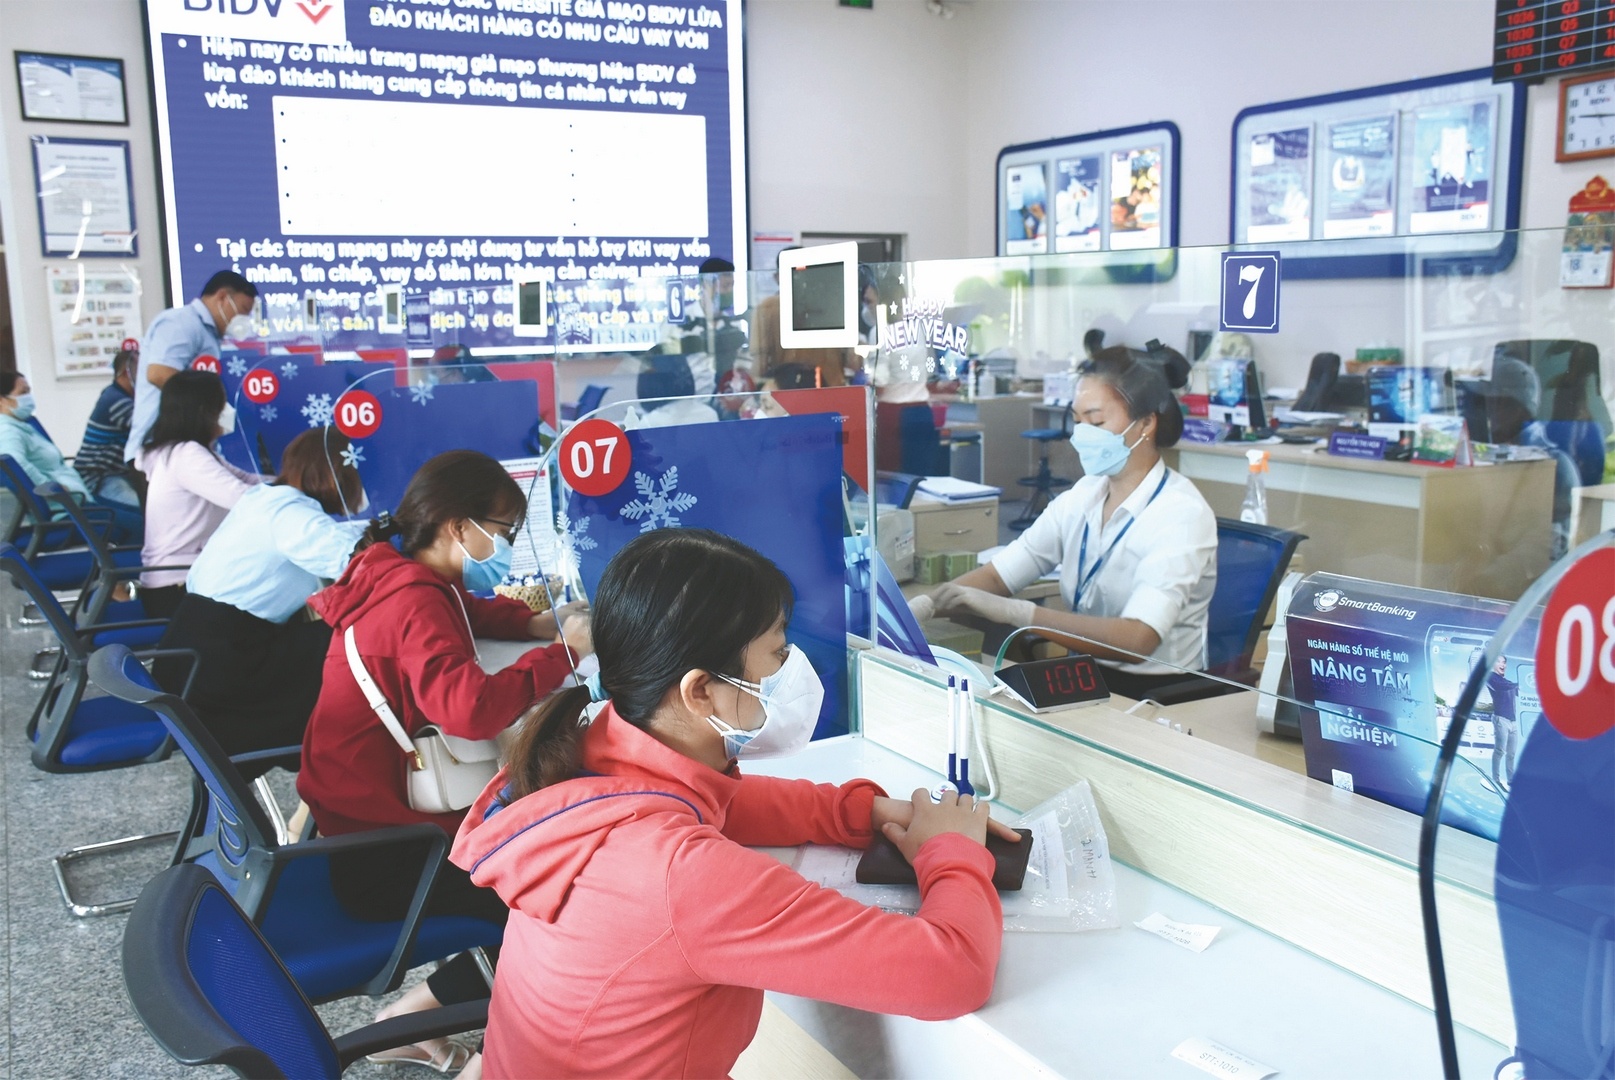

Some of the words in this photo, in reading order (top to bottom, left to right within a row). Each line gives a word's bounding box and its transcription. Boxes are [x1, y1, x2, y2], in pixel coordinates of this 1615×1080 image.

[607, 2, 646, 25] MẠO
[648, 5, 686, 25] BIDV
[415, 8, 479, 33] KHÁCH
[483, 12, 534, 37] HÀNG
[536, 17, 563, 39] CÓ
[565, 22, 601, 42] NHU
[641, 27, 673, 47] VAY
[674, 28, 709, 50] VỐN
[250, 42, 285, 64] nay
[288, 43, 313, 61] có
[369, 47, 417, 72] trang
[419, 53, 468, 75] mạng
[499, 58, 536, 79] mạo
[537, 57, 598, 83] thương
[636, 63, 675, 83] BIDV
[204, 84, 248, 110] vốn:
[279, 66, 336, 88] khách
[339, 70, 385, 95] hàng
[387, 76, 432, 98] cung
[434, 72, 467, 99] cấp
[468, 77, 517, 102] thông
[519, 80, 542, 99] tin
[544, 81, 565, 100] cá
[566, 83, 607, 102] nhân
[659, 91, 687, 110] vay
[216, 238, 247, 262] Tại
[250, 238, 284, 258] các
[286, 239, 335, 262] trang
[338, 242, 388, 262] mạng
[391, 238, 423, 262] này
[425, 238, 449, 258] có
[450, 239, 478, 262] nội
[480, 239, 523, 262] dung
[600, 240, 626, 261] trợ
[627, 240, 651, 257] KH
[653, 243, 680, 261] vay
[682, 238, 710, 257] vốn
[246, 263, 298, 285] nhân,
[300, 263, 325, 282] tín
[379, 267, 411, 285] vay
[414, 259, 437, 281] số
[474, 262, 502, 281] lớn
[670, 287, 681, 317] 6
[1239, 265, 1265, 320] 7
[902, 297, 945, 319] HAPPY
[431, 311, 465, 333] dịch
[883, 317, 921, 353] NEW
[922, 319, 968, 356] YEAR
[248, 377, 274, 396] 05
[341, 402, 376, 427] 06
[570, 436, 618, 478] 07
[1339, 597, 1416, 620] SmartBanking
[1307, 639, 1328, 650] NGÂN
[1329, 642, 1350, 654] HÀNG
[1352, 644, 1363, 656] SỐ
[1364, 647, 1380, 659] THẾ
[1381, 649, 1391, 662] HỆ
[1393, 652, 1409, 663] MỚI
[1045, 661, 1097, 694] 100
[1311, 656, 1367, 683] NÂNG
[1372, 664, 1411, 689] TẦM
[1327, 722, 1397, 746] NGHIỆM
[1199, 1052, 1240, 1075] STT:1010
